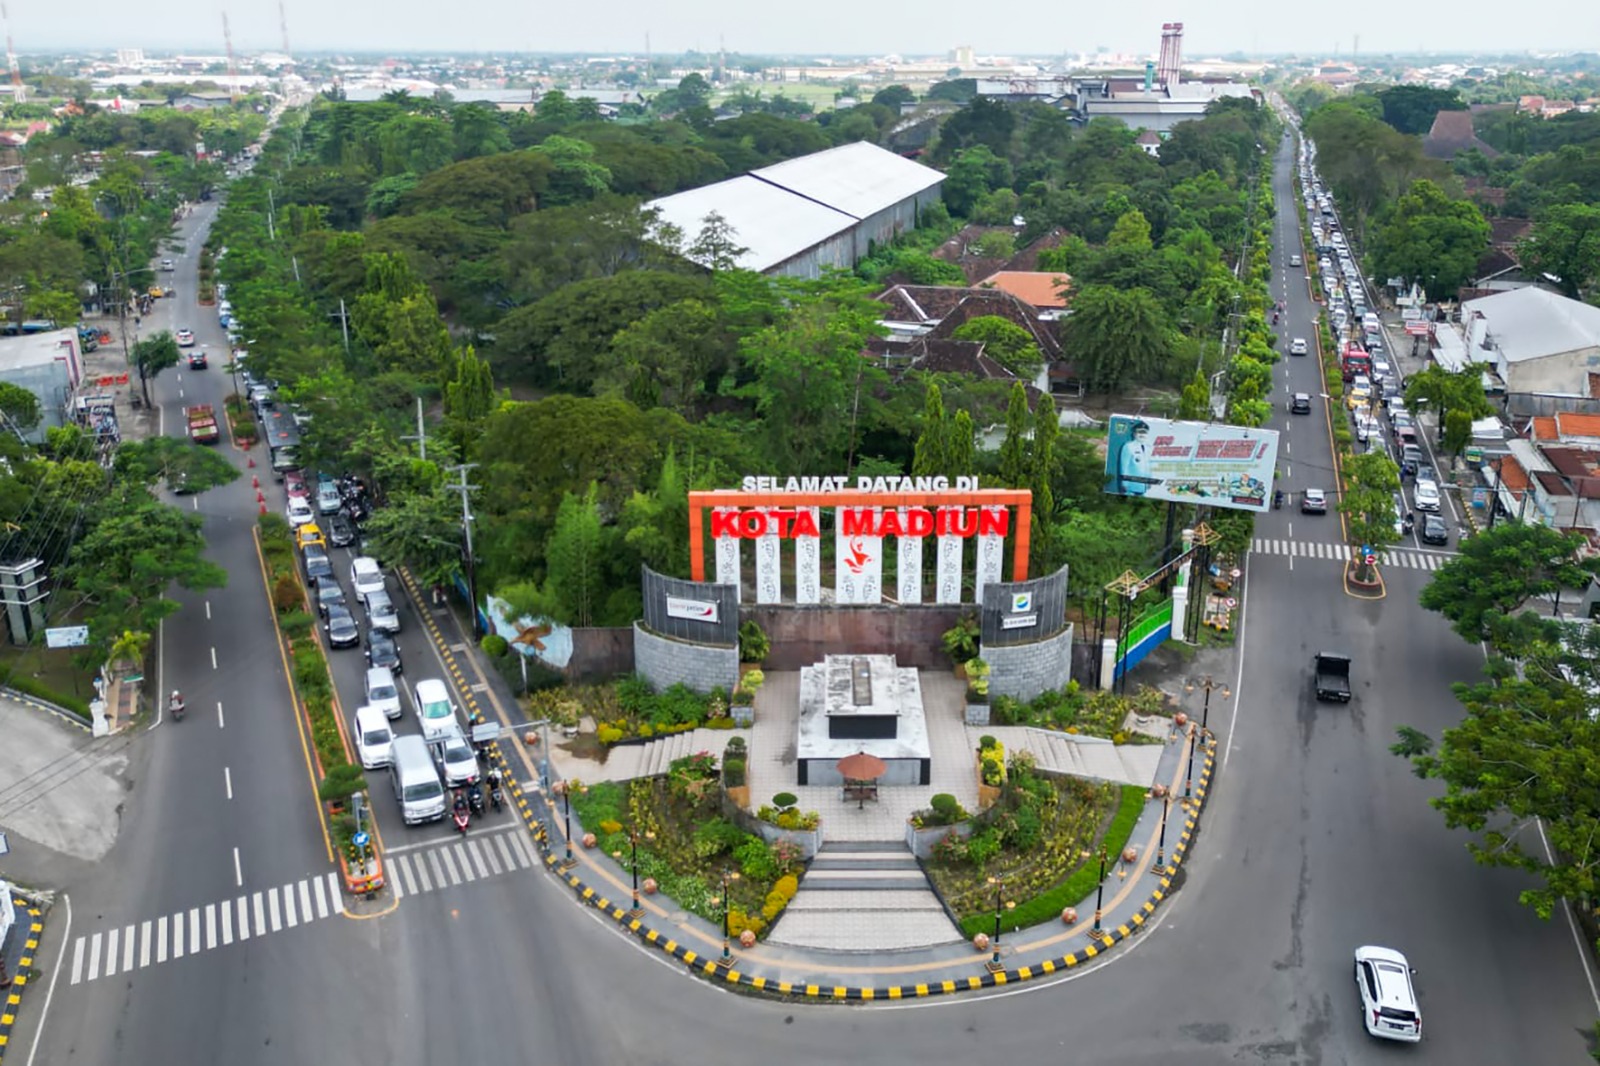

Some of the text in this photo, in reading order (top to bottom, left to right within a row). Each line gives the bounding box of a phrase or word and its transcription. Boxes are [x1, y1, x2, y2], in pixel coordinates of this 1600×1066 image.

[742, 475, 978, 492] SELAMAT DATANG DI
[710, 507, 1010, 539] KOTA MADIUN
